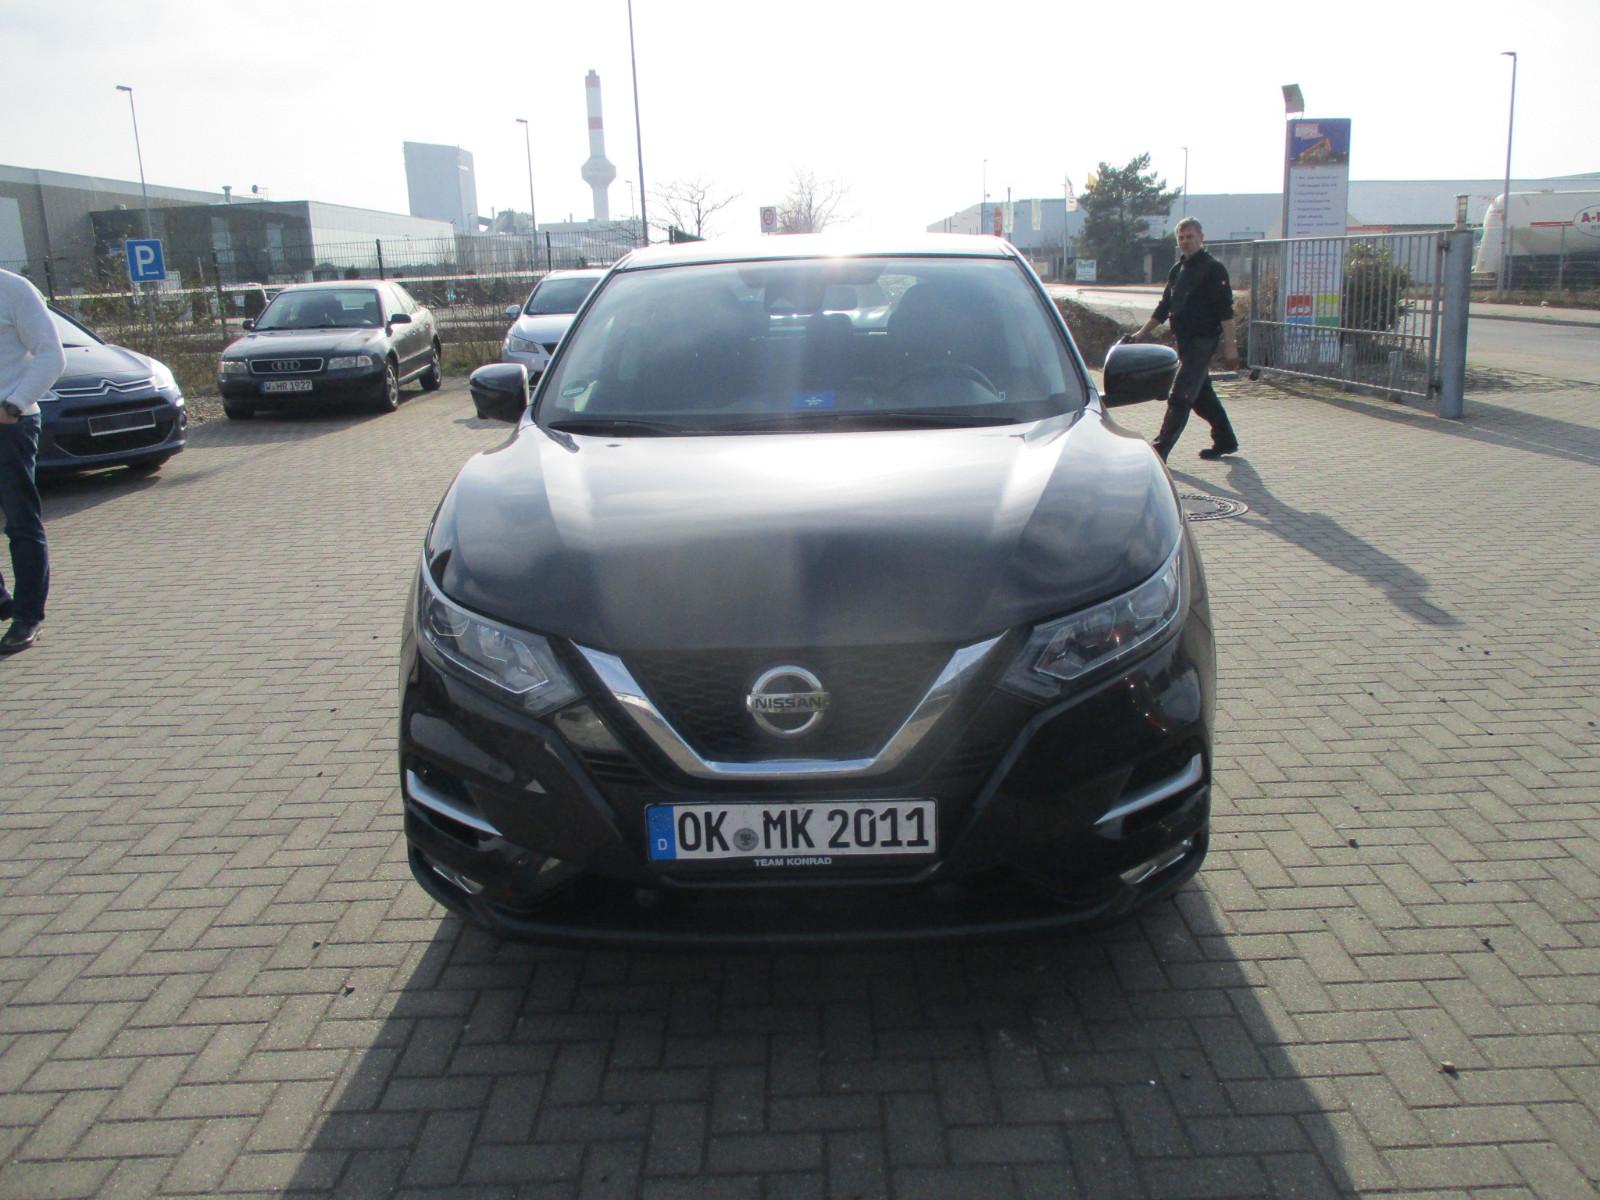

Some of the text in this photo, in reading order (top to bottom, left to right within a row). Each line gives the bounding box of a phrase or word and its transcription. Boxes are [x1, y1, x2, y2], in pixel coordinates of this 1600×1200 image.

[135, 245, 155, 277] P
[755, 695, 822, 709] NISSAN
[657, 807, 930, 852] D OK MK 2011
[754, 856, 832, 867] TEAM KONRAD
